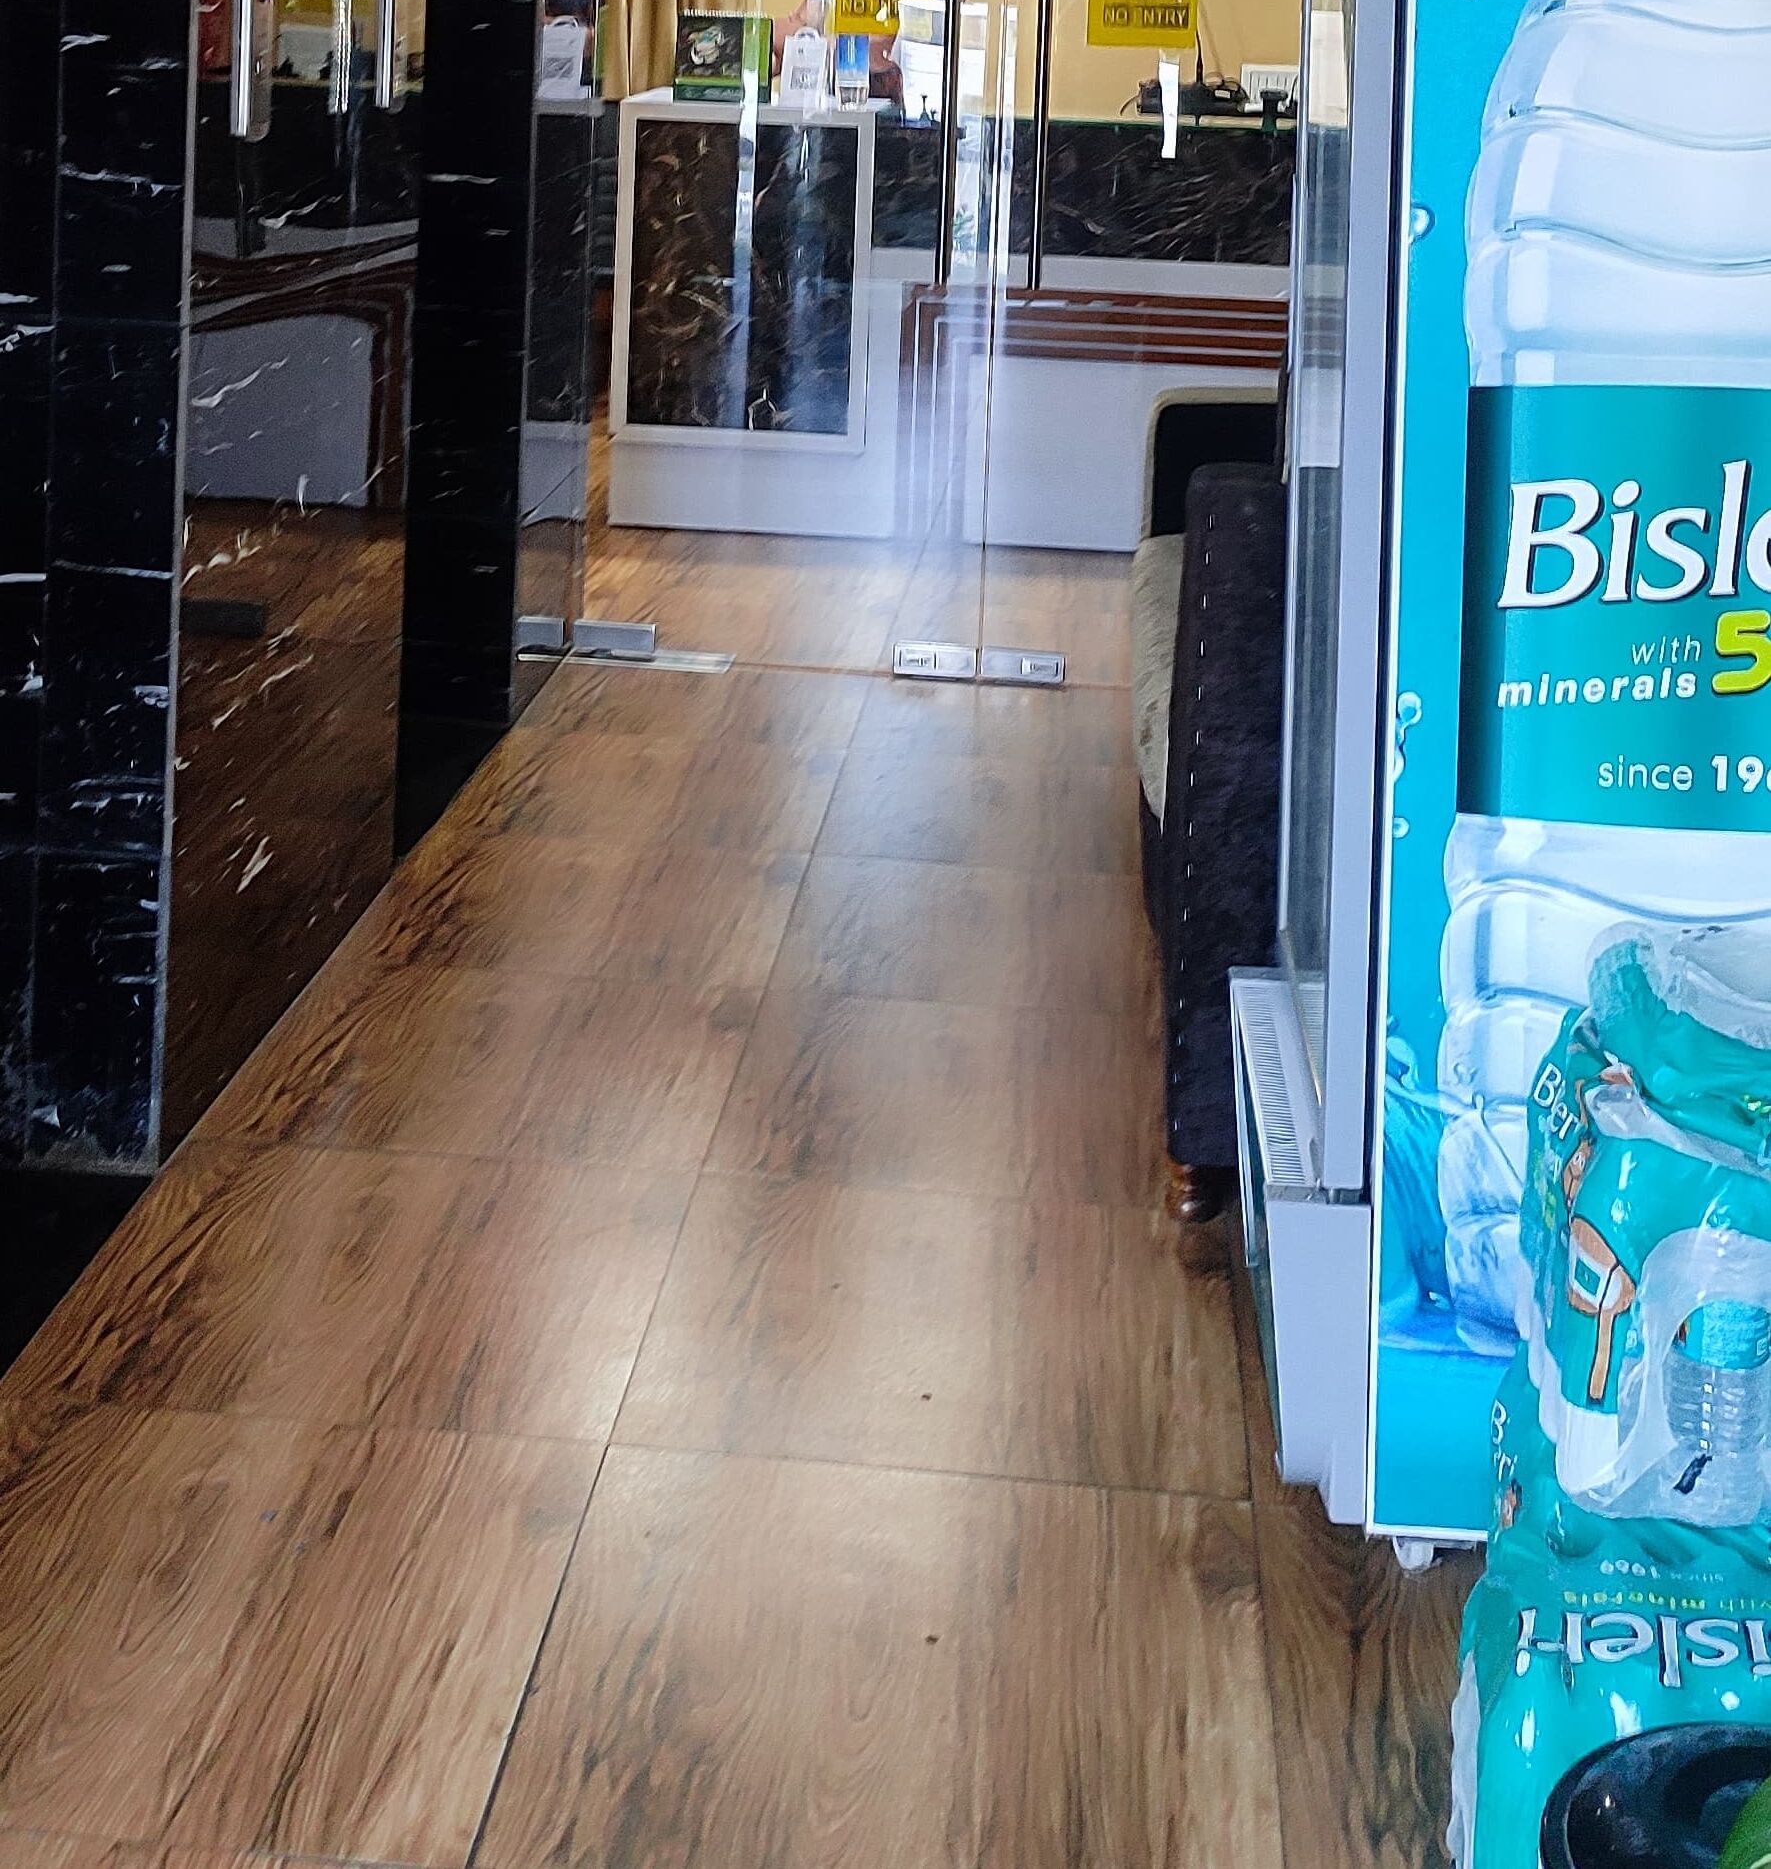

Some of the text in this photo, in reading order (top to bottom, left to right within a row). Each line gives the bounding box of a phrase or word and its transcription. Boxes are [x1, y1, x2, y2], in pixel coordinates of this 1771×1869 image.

[1104, 7, 1128, 27] NO
[1631, 610, 1771, 694] with 5
[1497, 667, 1696, 708] minerals
[1598, 754, 1771, 793] since 19
